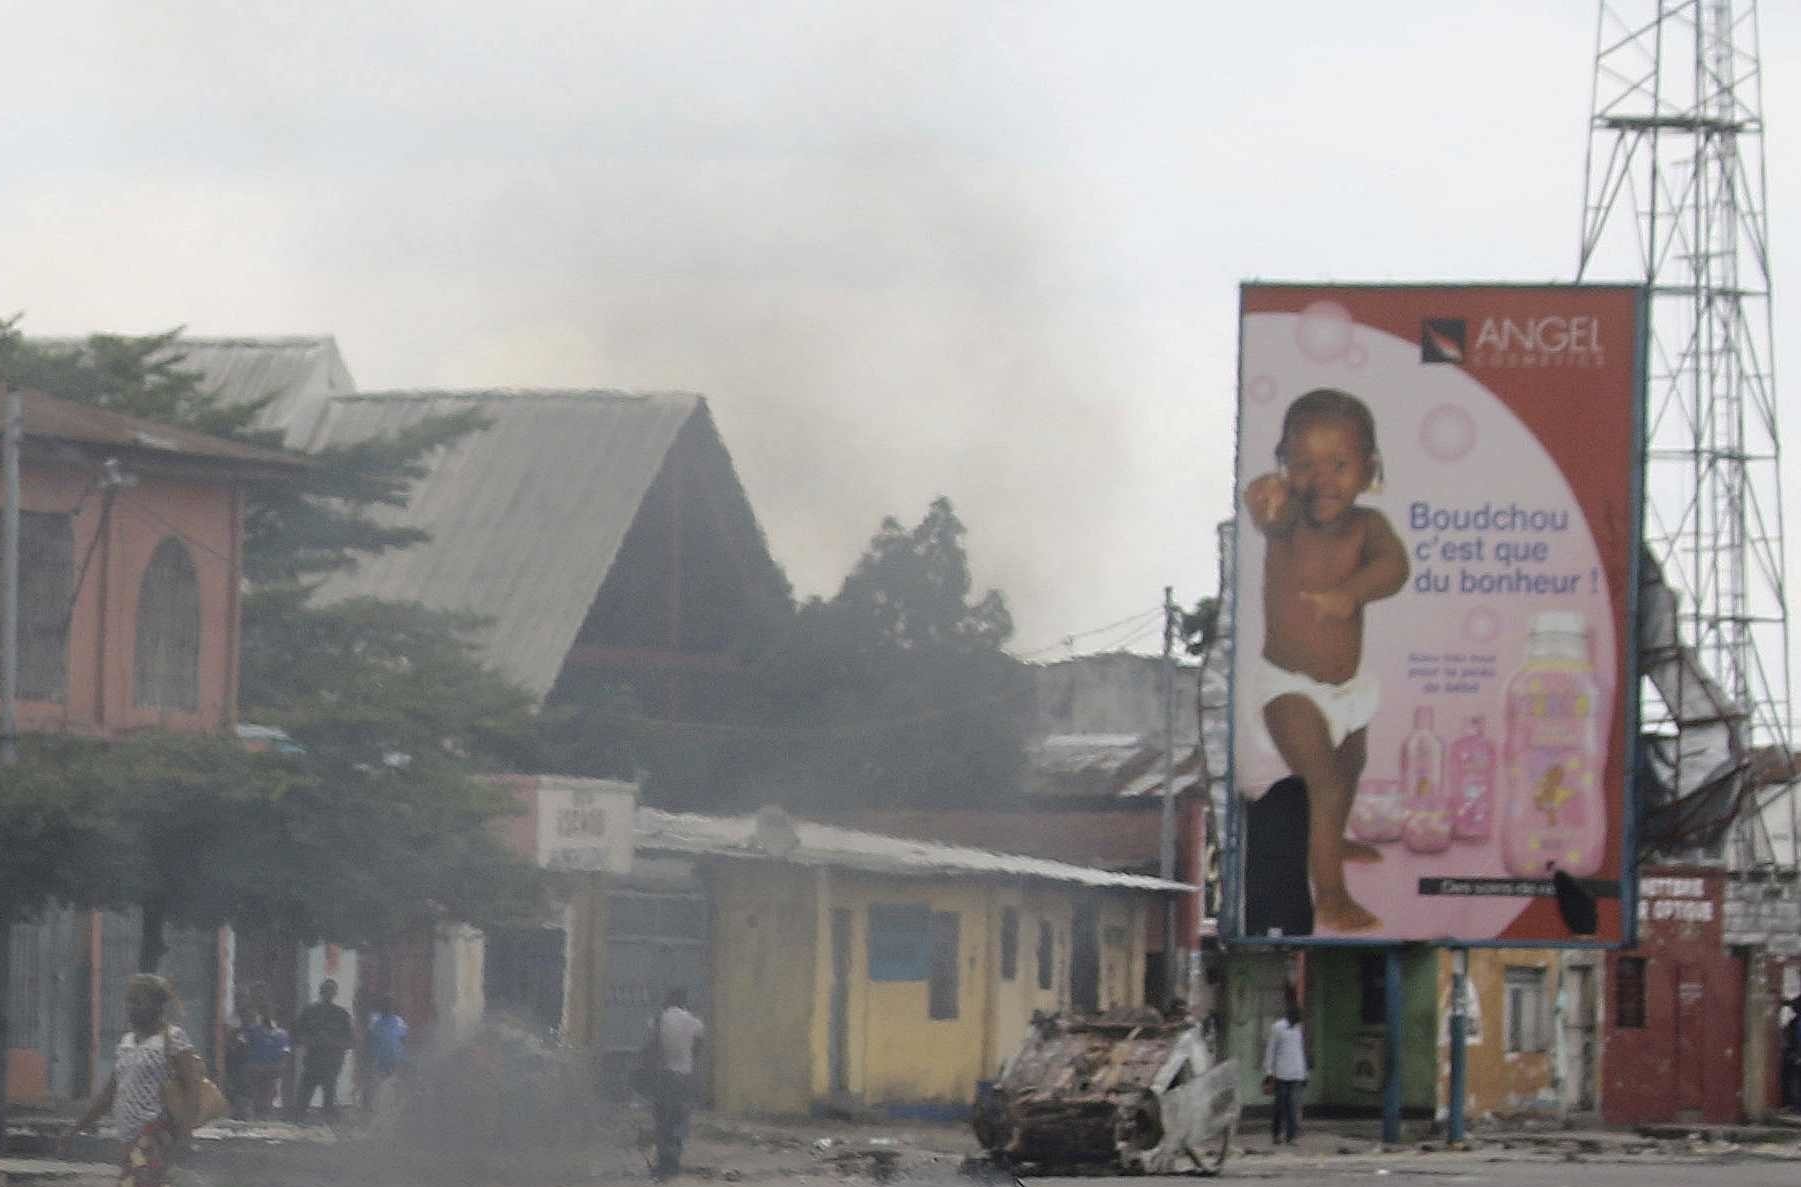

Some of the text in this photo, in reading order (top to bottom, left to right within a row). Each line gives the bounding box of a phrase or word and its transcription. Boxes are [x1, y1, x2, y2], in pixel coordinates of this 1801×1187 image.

[1474, 314, 1602, 352] ANGEL
[1410, 502, 1568, 530] Boudchou
[1415, 534, 1549, 566] c'est que
[1414, 569, 1449, 593] du
[1459, 569, 1580, 594] bonheur
